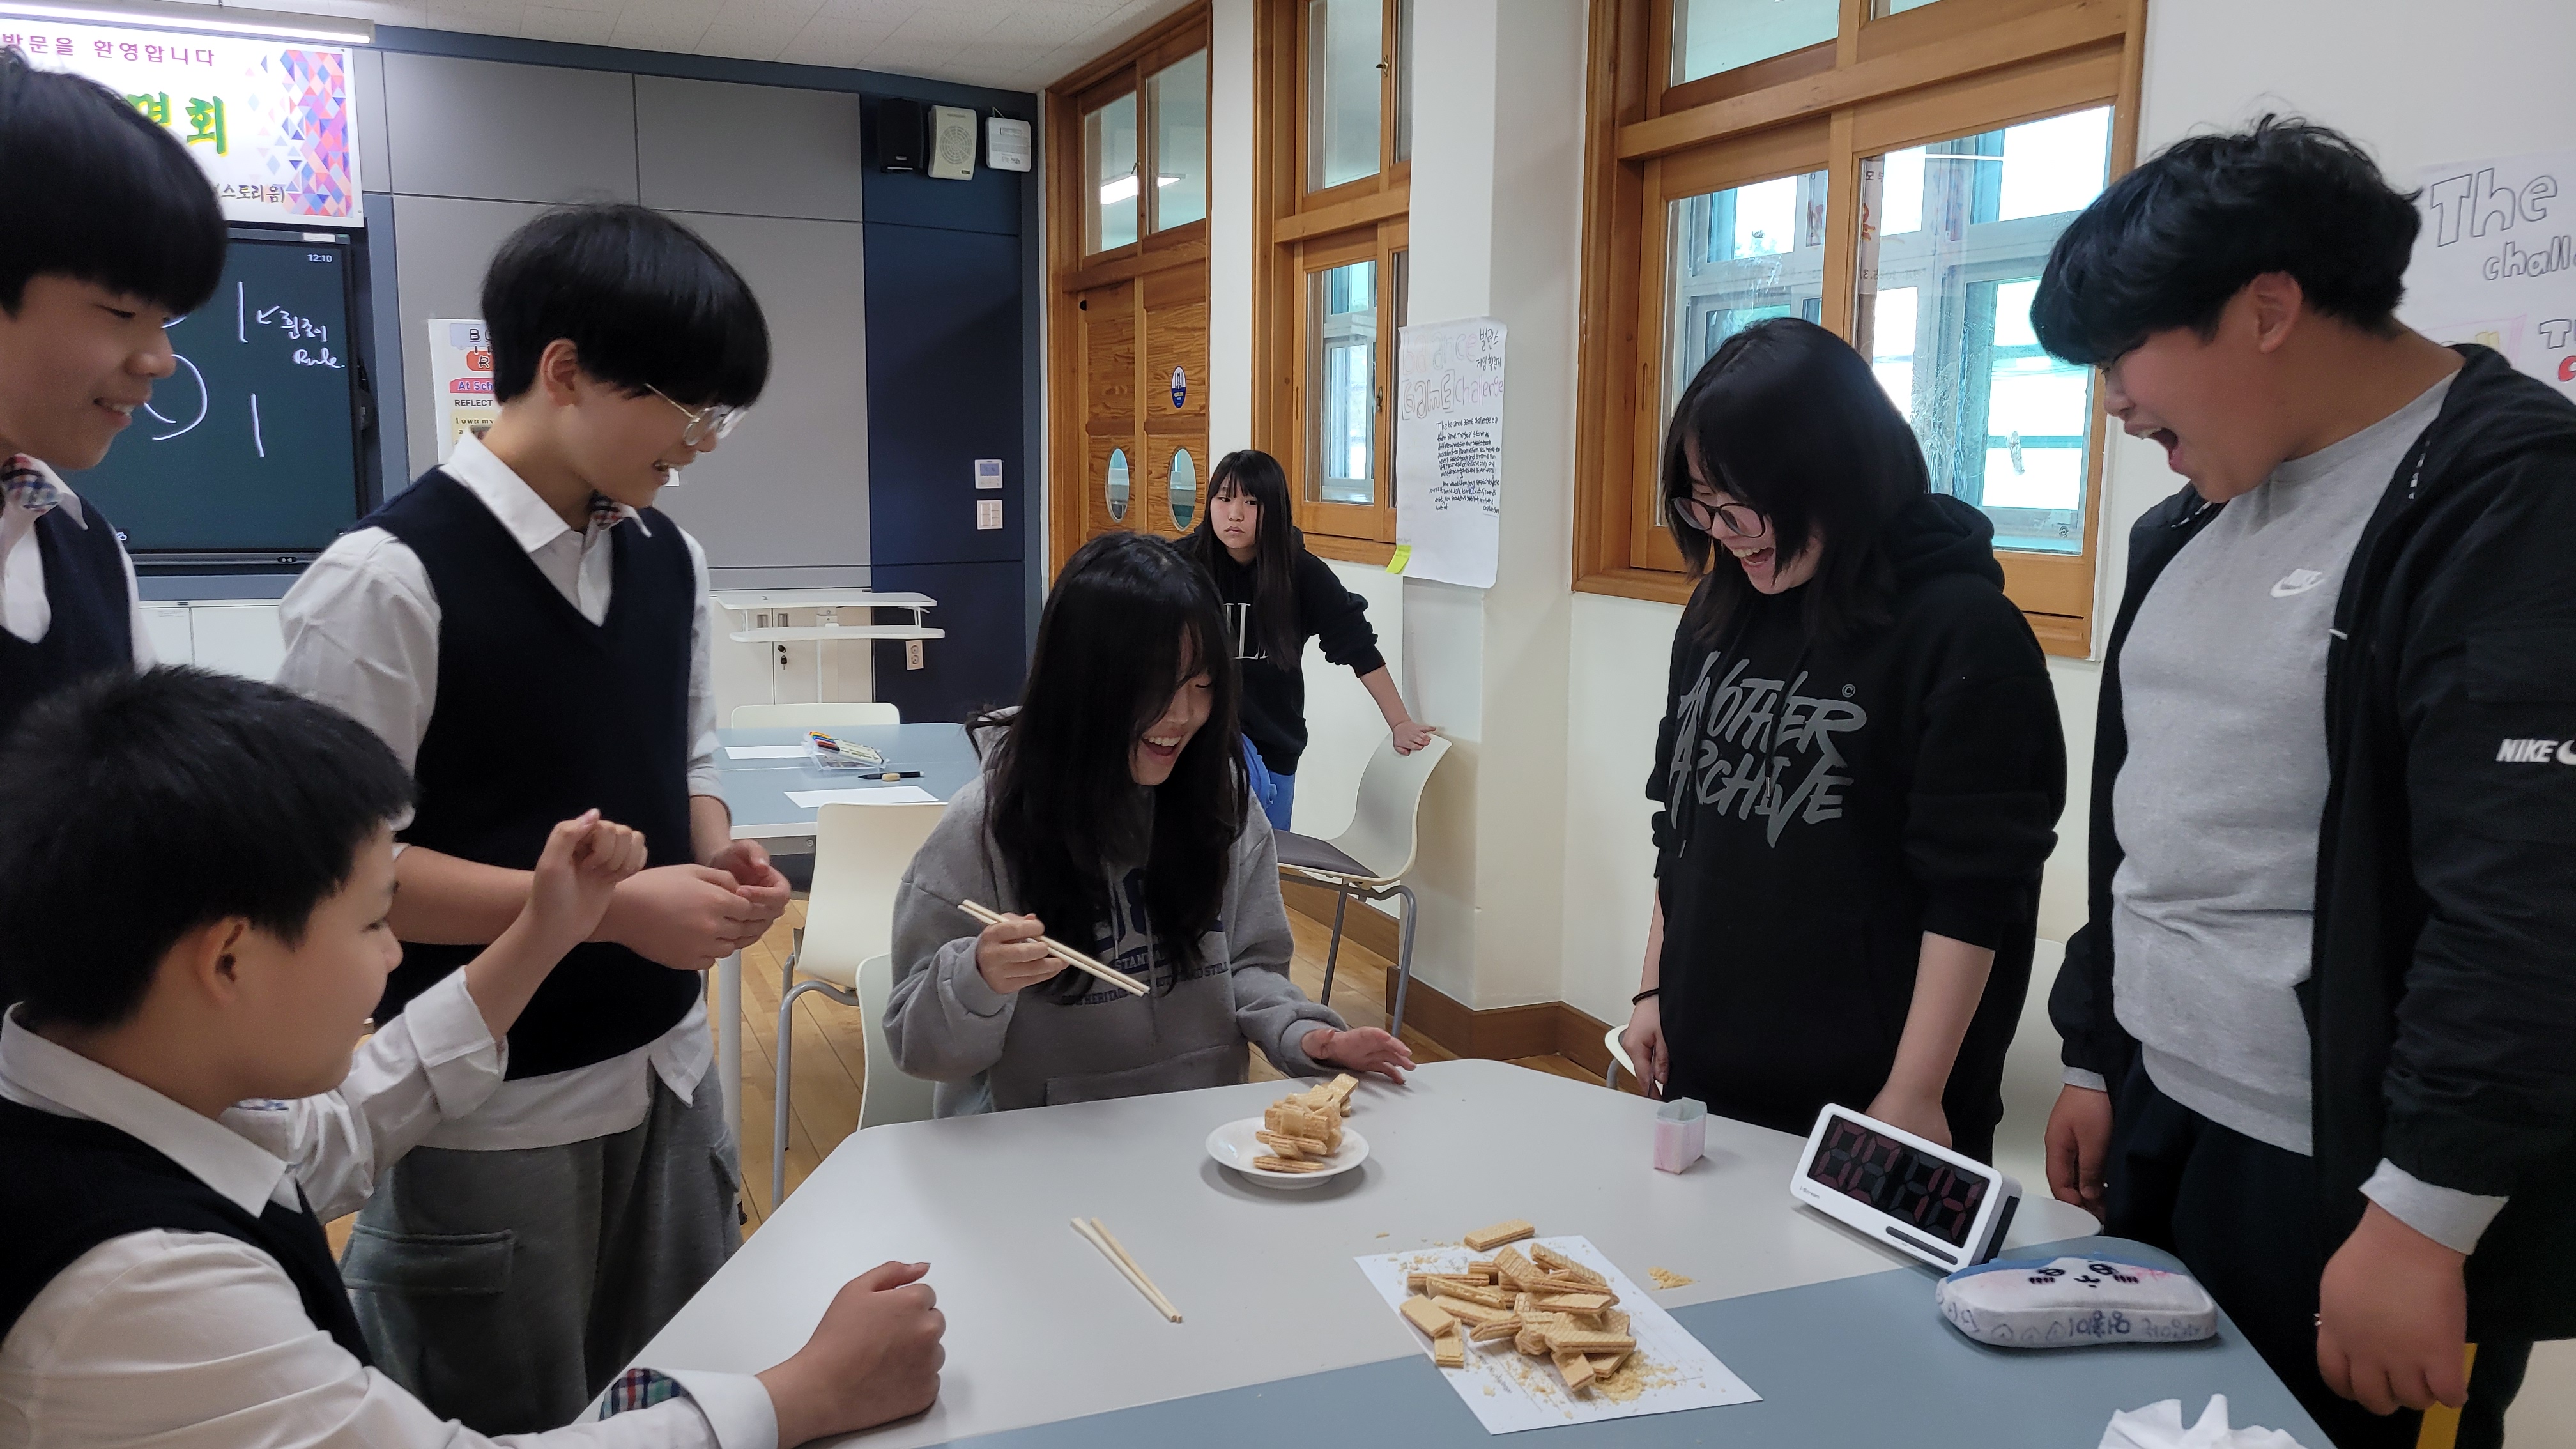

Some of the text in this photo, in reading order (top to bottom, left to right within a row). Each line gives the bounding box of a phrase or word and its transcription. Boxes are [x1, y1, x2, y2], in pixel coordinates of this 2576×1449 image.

[93, 40, 215, 67] 환영합니다
[2430, 167, 2558, 248] The
[308, 254, 333, 263] 12:10
[2483, 235, 2576, 281] chall
[458, 381, 470, 390] At
[1436, 420, 1448, 432] The
[2495, 738, 2559, 763] NIKE
